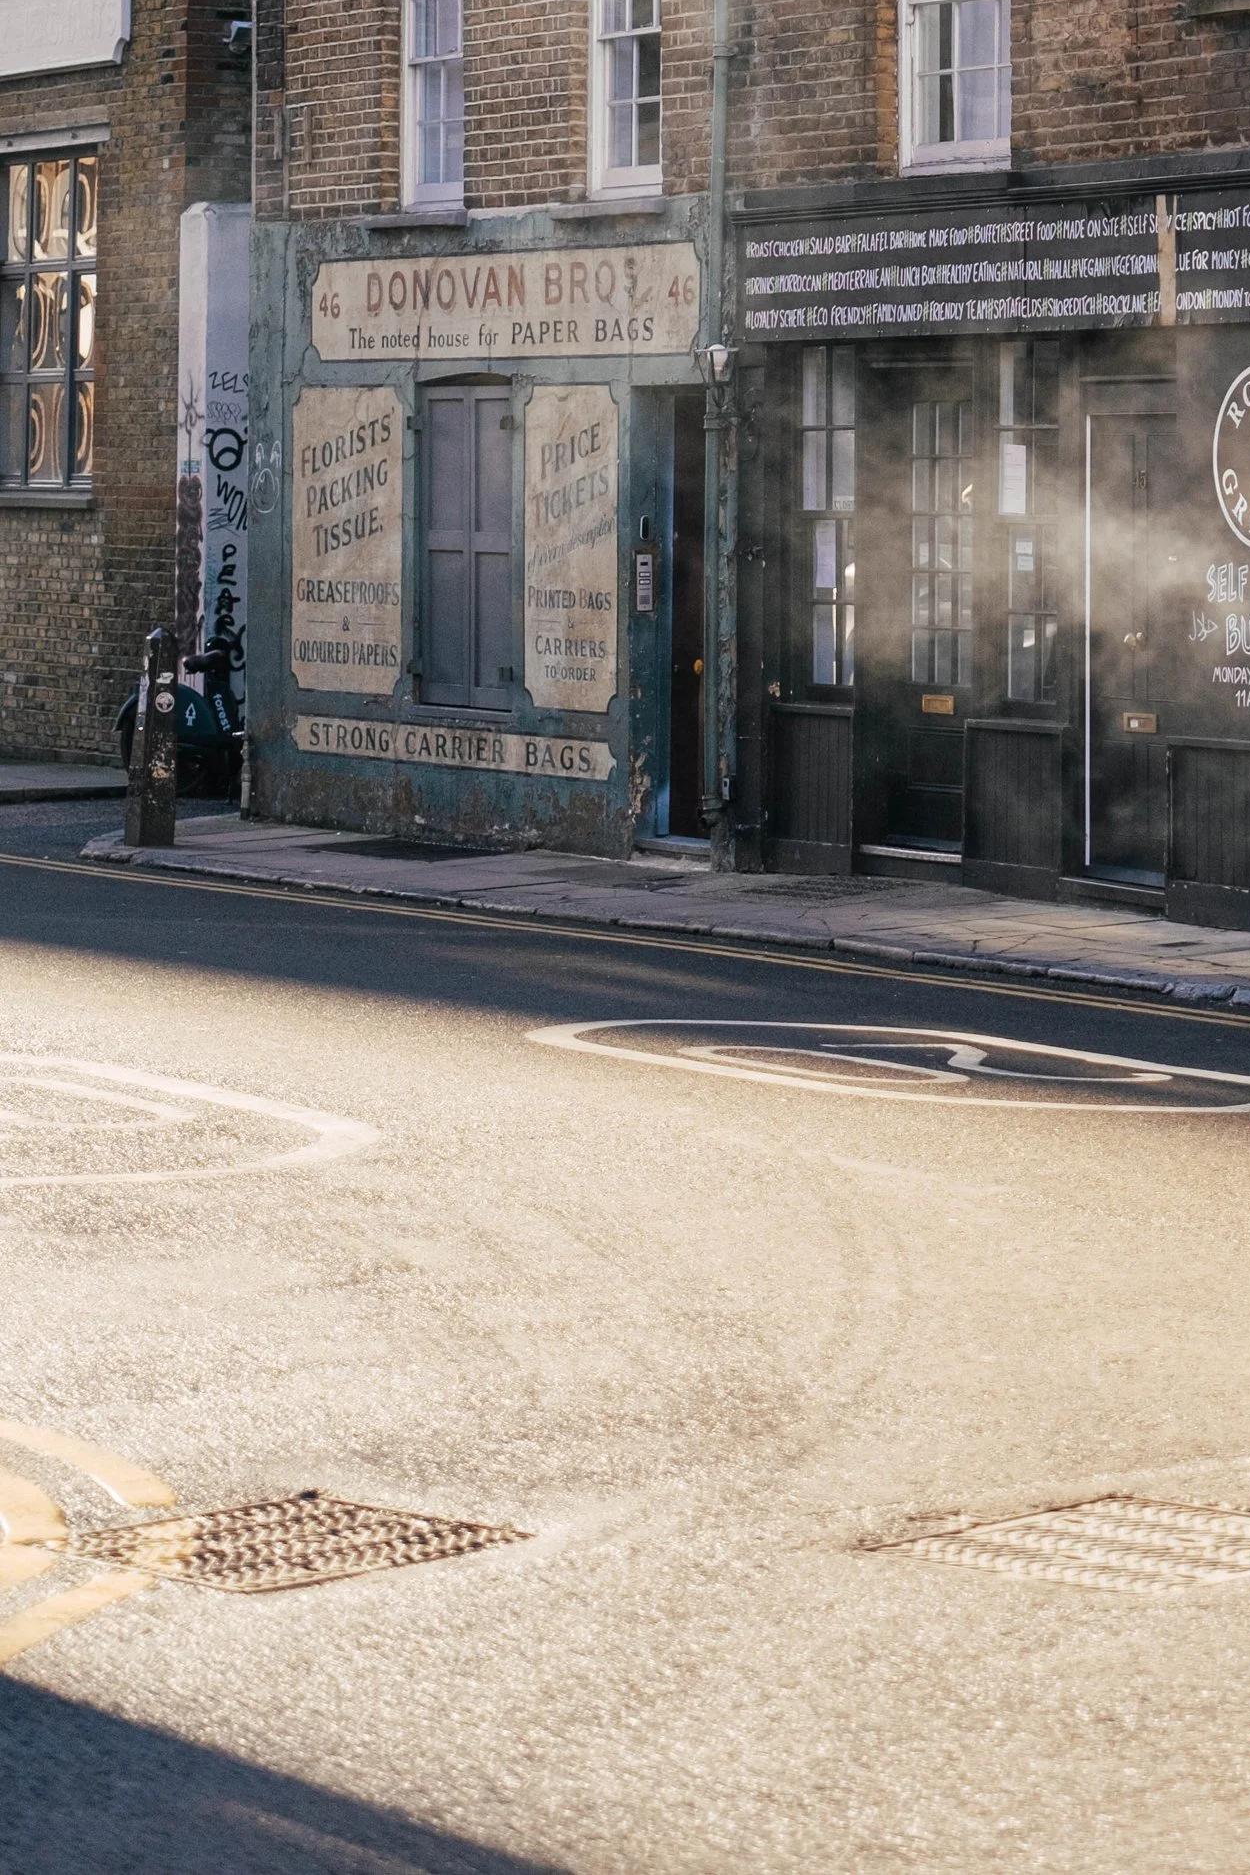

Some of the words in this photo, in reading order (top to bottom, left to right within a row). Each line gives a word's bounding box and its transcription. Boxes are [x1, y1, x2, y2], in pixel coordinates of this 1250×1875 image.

[1212, 248, 1240, 270] MONEY
[319, 292, 341, 319] 46
[367, 263, 525, 313] DONOVAN
[667, 275, 696, 307] 46
[349, 327, 376, 350] The
[381, 325, 420, 349] noted
[428, 325, 470, 348] house
[478, 323, 500, 346] for
[511, 319, 581, 345] PAPER
[594, 317, 654, 342] BAGS
[540, 421, 601, 481] PRICE
[306, 458, 388, 519] PACKING
[532, 464, 609, 527] TICKETS
[296, 577, 400, 606] GREASEPROOFS
[527, 585, 576, 609] PRINTED
[580, 588, 612, 611] BAGS
[1206, 562, 1249, 603] SELF
[342, 615, 350, 632] &
[293, 638, 350, 665] COLOURED
[535, 635, 606, 659] CARRIERS
[544, 665, 557, 679] TO
[560, 666, 597, 682] ORDER
[212, 692, 232, 733] forest
[309, 722, 390, 753] STRONG
[404, 731, 506, 763] CARRIER
[525, 742, 592, 773] BAGS
